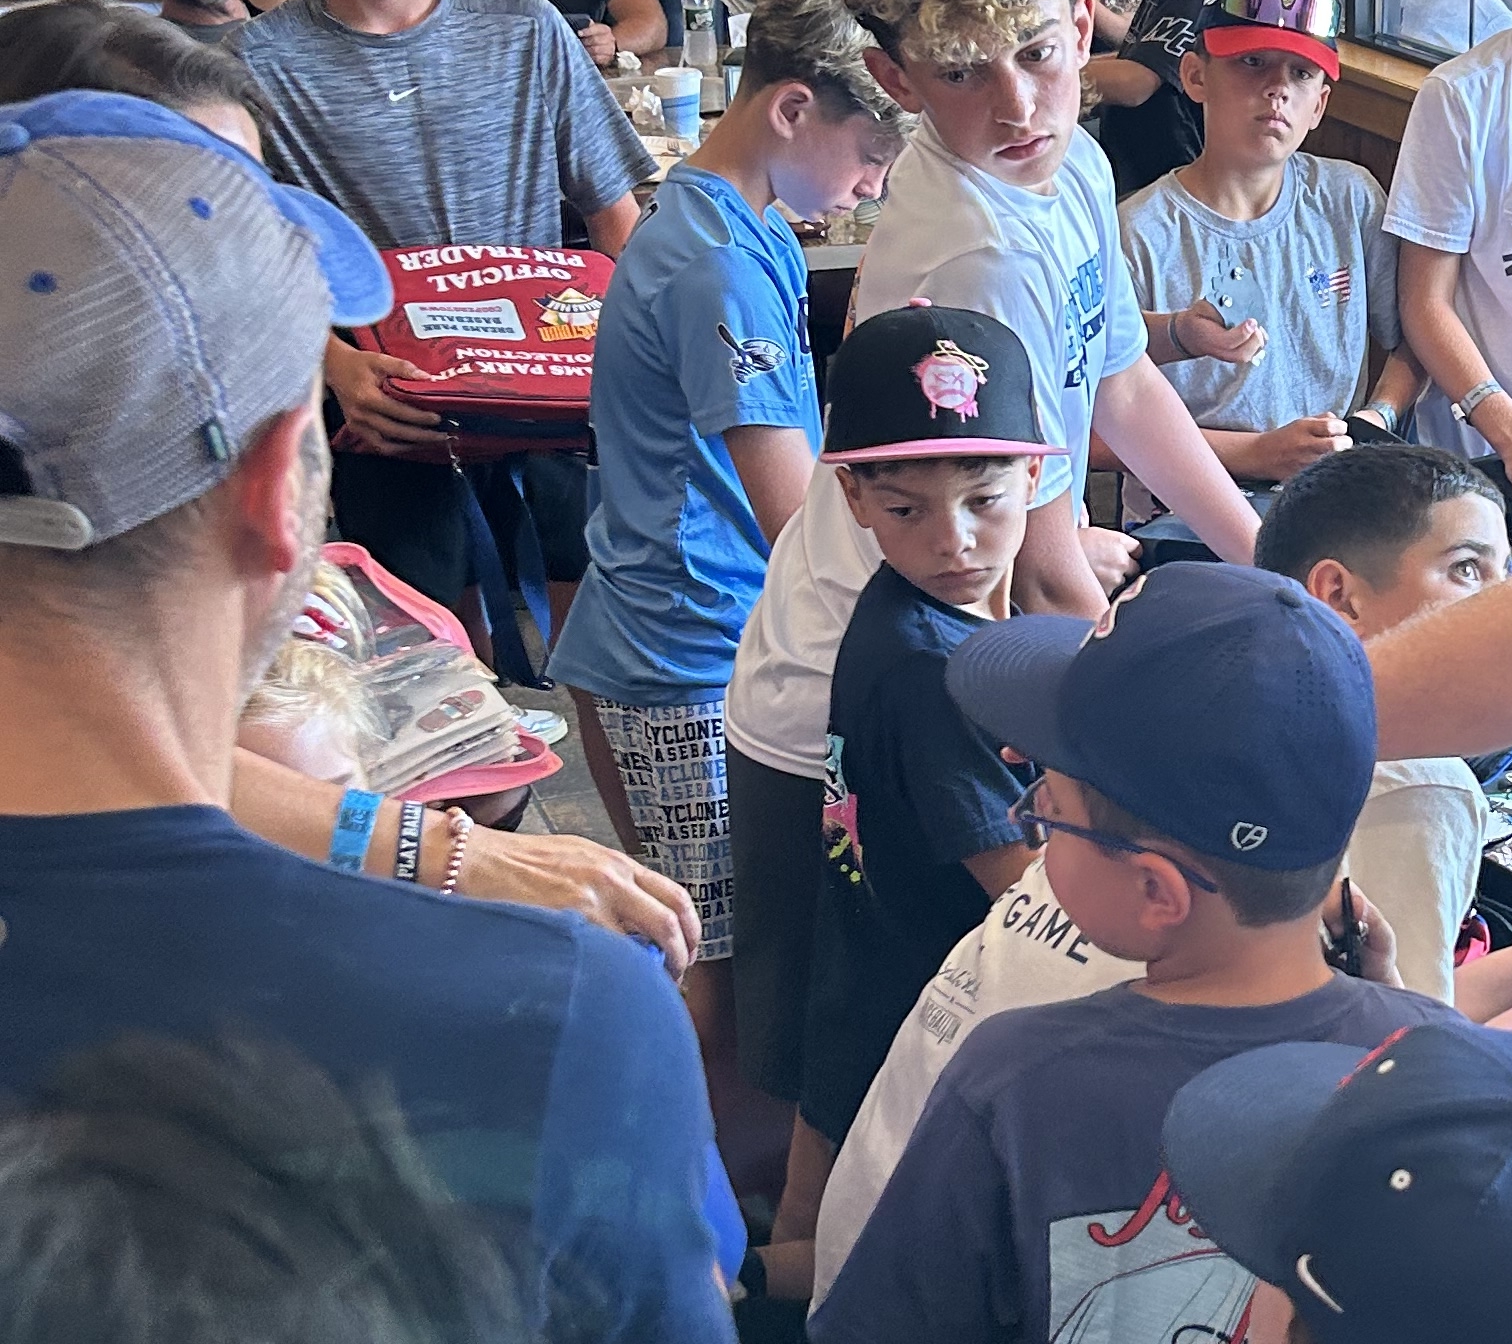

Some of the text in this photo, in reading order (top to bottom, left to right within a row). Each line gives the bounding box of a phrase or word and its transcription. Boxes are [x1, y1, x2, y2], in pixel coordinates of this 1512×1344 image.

[1141, 16, 1198, 57] MC
[395, 244, 587, 272] PIN TRADER
[426, 263, 573, 293] OFFICIAL
[422, 323, 516, 335] DREAMS PARK
[426, 313, 504, 325] BASEBALL
[455, 346, 595, 364] OLLECTION
[474, 360, 548, 376] PARK
[397, 838, 419, 879] PLAY
[1003, 892, 1091, 965] GAME
